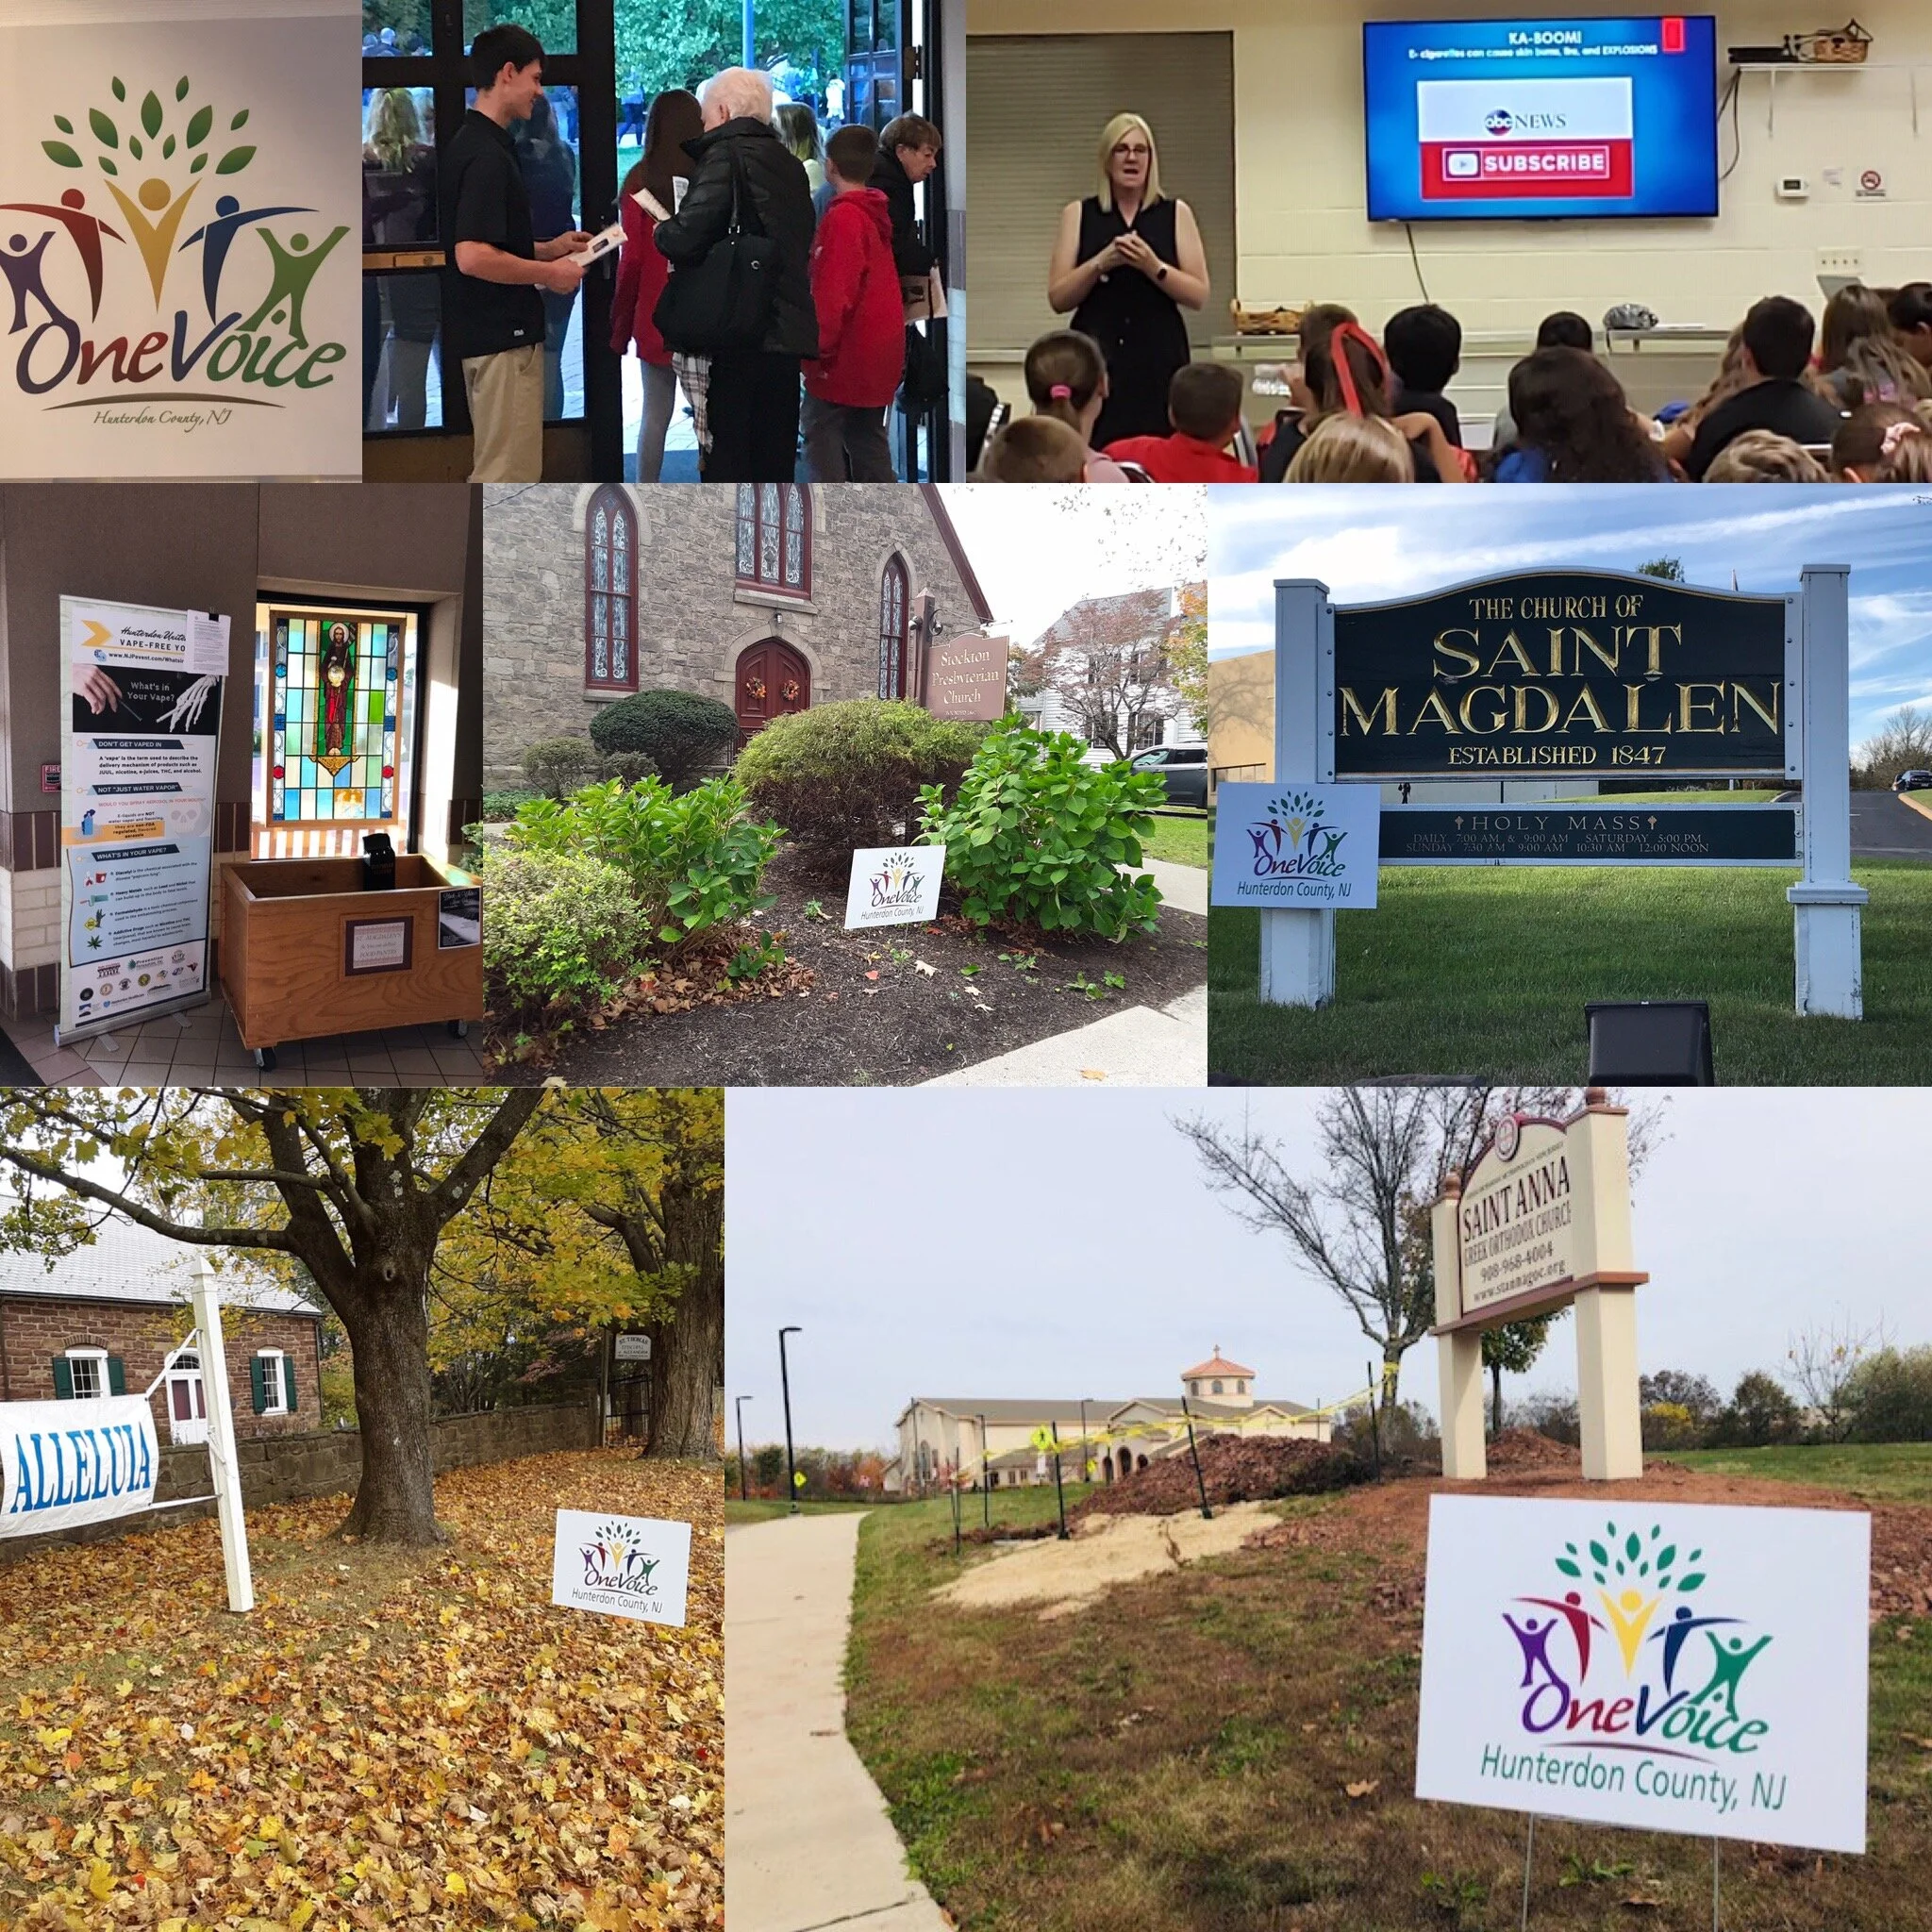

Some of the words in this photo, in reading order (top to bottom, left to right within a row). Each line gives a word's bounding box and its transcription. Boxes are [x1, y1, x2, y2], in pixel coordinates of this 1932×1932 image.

[1509, 31, 1582, 45] KA-BOOM!
[1420, 49, 1465, 60] cigarettes
[1467, 50, 1485, 58] can
[1487, 49, 1513, 58] cause
[1516, 48, 1533, 57] skin
[1582, 45, 1601, 56] and
[1603, 44, 1657, 56] EXPLOSIONS
[1484, 112, 1513, 131] abc
[1515, 114, 1567, 129] NEWS
[1484, 155, 1606, 172] SUBSCRIBE
[16, 309, 347, 394] OneVoice
[93, 406, 157, 425] Hunterdon
[158, 410, 204, 433] County,
[207, 408, 233, 425] NJ
[1469, 597, 1514, 619] THE
[1521, 596, 1607, 619] CHURCH
[1616, 594, 1643, 618] OF
[121, 626, 163, 640] Hunterdon
[120, 639, 171, 651] VAPE-FREE
[1433, 622, 1682, 678] SAINT
[941, 649, 990, 666] Stockton
[131, 682, 160, 691] What's
[932, 667, 999, 687] Presbyterian
[127, 691, 147, 701] Your
[150, 692, 175, 702] Vape?
[944, 688, 981, 704] Church
[1339, 681, 1780, 737] MAGDALEN
[1448, 746, 1597, 766] ESTABLISHED
[1610, 746, 1667, 765] 1847
[1471, 816, 1549, 830] HOLY
[1568, 816, 1640, 830] MASS
[1406, 844, 1453, 852] SUNDAY
[1463, 844, 1483, 852] 7:30
[1486, 844, 1506, 852] AM
[1518, 844, 1540, 852] 9:00
[1544, 844, 1562, 852] AM
[1577, 844, 1602, 852] 10:30
[1606, 844, 1625, 852] AM
[1639, 844, 1666, 852] 12:00
[1671, 843, 1709, 852] NOON
[1414, 834, 1447, 843] DAILY
[1456, 834, 1476, 843] 7:00
[1481, 834, 1499, 843] AM
[1508, 834, 1515, 843] &
[1524, 834, 1546, 843] 9:00
[1549, 834, 1568, 843] AM
[1586, 834, 1648, 843] SATURDAY
[1658, 834, 1679, 843] 5:00
[1684, 834, 1701, 843] PM
[97, 851, 121, 860] WHAT'S
[1254, 853, 1346, 877] OneVoice
[872, 891, 922, 907] OneVoice
[1237, 881, 1293, 896] Hunterdon
[1297, 882, 1335, 900] County,
[1339, 883, 1351, 897] NJ
[861, 910, 893, 920] Hunterdon
[894, 907, 914, 918] County,
[916, 906, 924, 914] NJ
[1464, 1186, 1512, 1242] SAINT
[1516, 1156, 1570, 1219] ANNA
[1481, 1241, 1553, 1283] 908-968-4004
[9, 1421, 150, 1513] ALLELUIA
[585, 1570, 658, 1596] OneVoice
[572, 1588, 615, 1605] Hunterdon
[618, 1596, 648, 1614] County,
[652, 1602, 663, 1613] NJ
[1521, 1683, 1769, 1753] OneVoice
[1481, 1744, 1625, 1792] Hunterdon
[1636, 1760, 1738, 1813] County,
[1752, 1772, 1787, 1811] NJ
